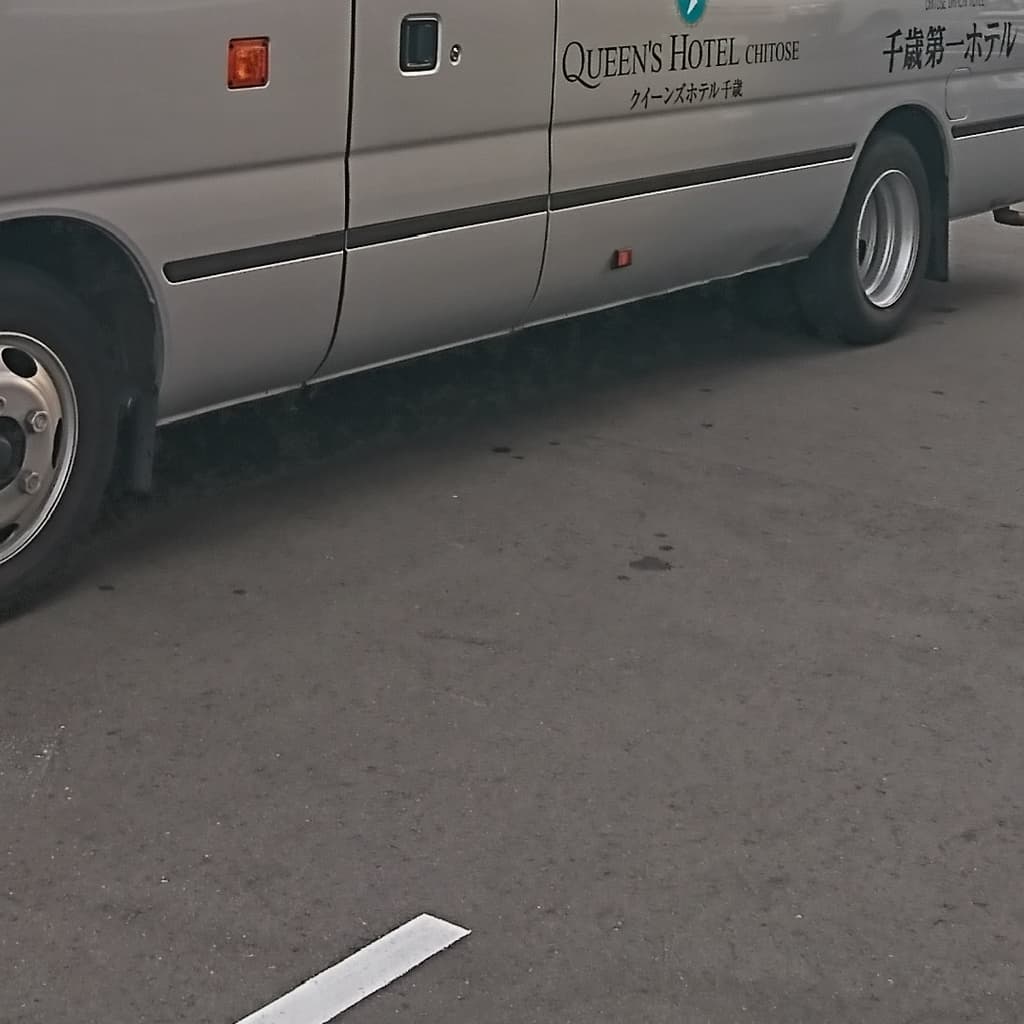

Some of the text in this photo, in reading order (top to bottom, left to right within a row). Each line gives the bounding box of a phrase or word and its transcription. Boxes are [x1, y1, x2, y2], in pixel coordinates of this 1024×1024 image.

[562, 34, 800, 89] QUEEN'S HOTEL CHITOSE
[883, 22, 1017, 73] 千歳第一ホテル
[630, 78, 743, 111] クイーンズホテル千歳
